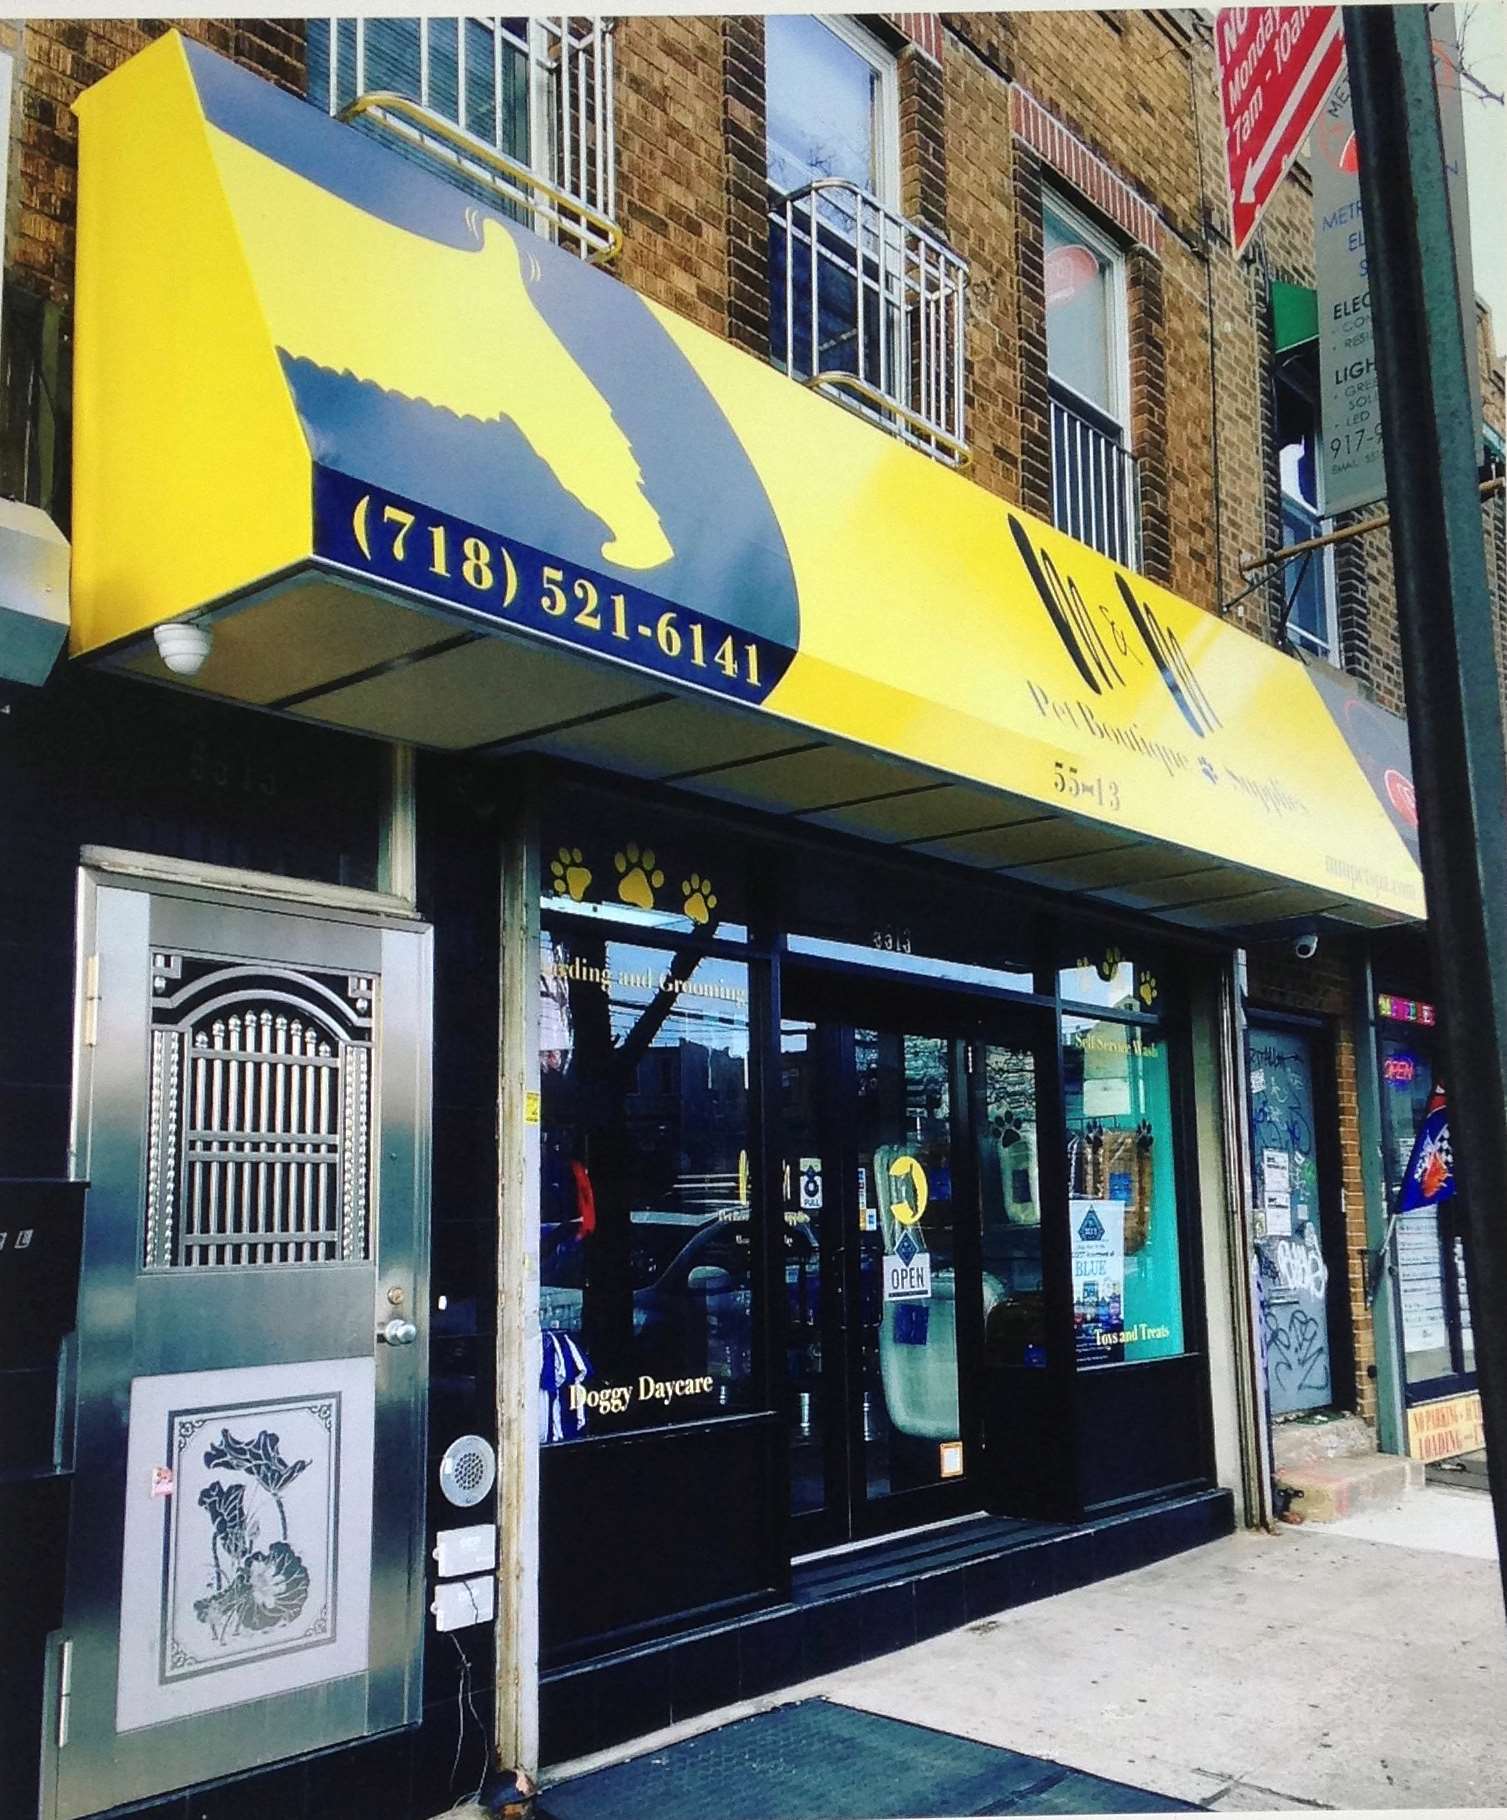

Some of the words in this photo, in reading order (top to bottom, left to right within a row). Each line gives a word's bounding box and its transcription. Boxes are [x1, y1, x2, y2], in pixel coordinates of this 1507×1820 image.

[353, 496, 519, 607] (718)
[540, 566, 762, 687] 521-6141
[1053, 761, 1121, 812] 55-13
[619, 968, 652, 989] and
[660, 970, 747, 1008] Grooming
[891, 1267, 925, 1289] OPEN
[1075, 1260, 1106, 1276] BLUE
[1094, 1328, 1118, 1346] Toys
[1119, 1324, 1138, 1343] and
[1138, 1323, 1169, 1341] Treats
[569, 1383, 633, 1415] Doggy
[638, 1375, 713, 1406] Daycare
